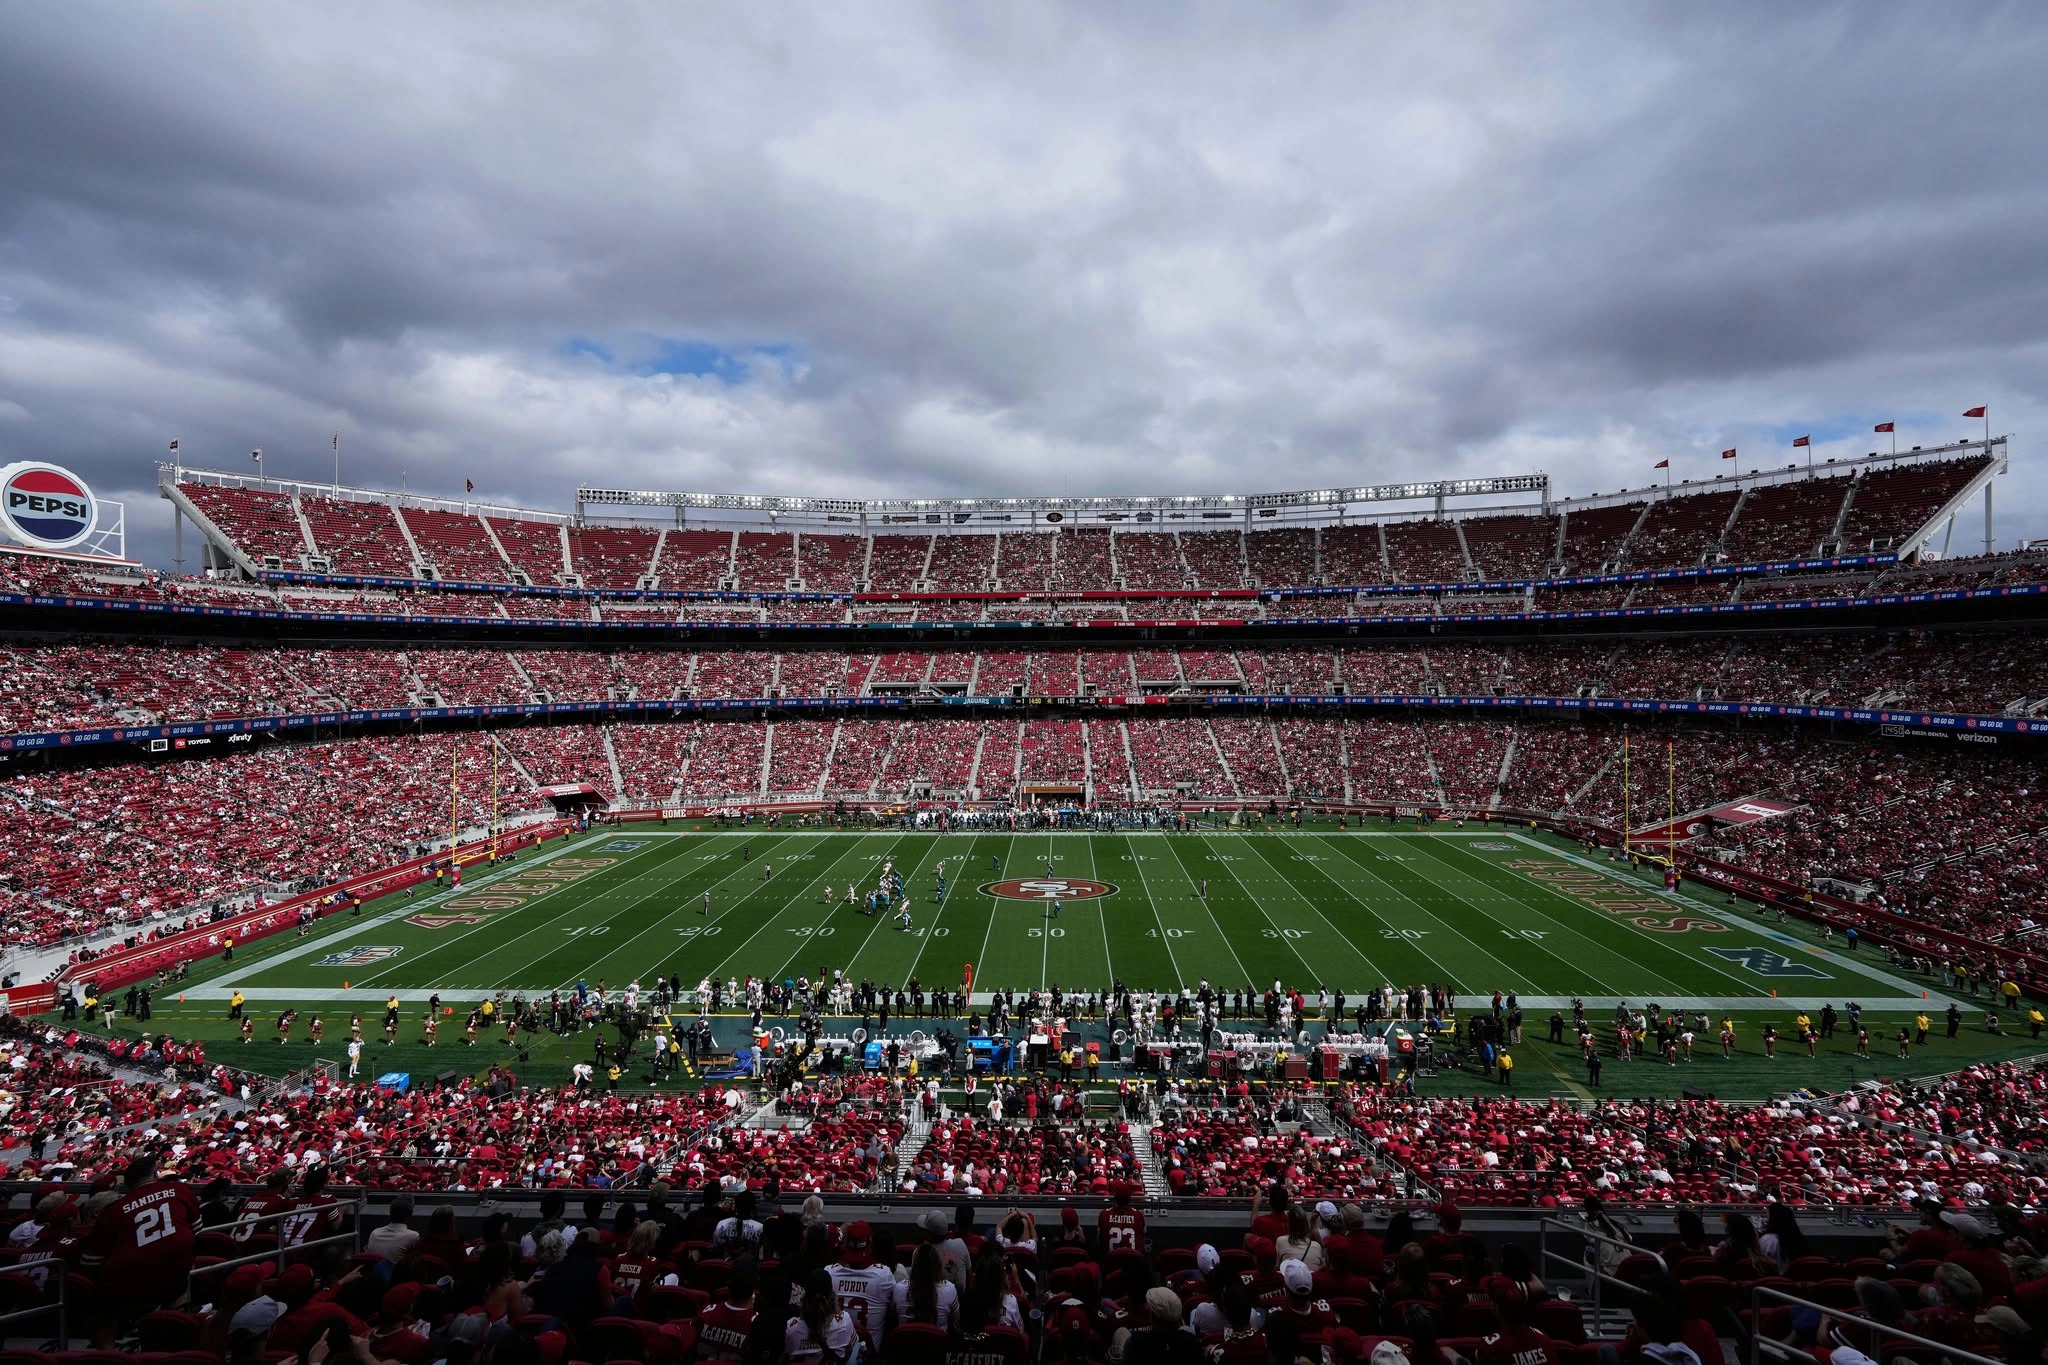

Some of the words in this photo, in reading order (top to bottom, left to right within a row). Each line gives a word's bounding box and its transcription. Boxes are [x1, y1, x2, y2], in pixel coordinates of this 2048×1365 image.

[10, 492, 87, 518] PEPSI
[1941, 717, 1947, 725] GO
[1980, 720, 1987, 728] GO
[1996, 721, 2003, 729] GO
[75, 734, 82, 742] GO
[83, 734, 91, 742] GO
[92, 733, 100, 741] GO
[127, 730, 134, 738] GO
[134, 729, 142, 738] GO
[142, 729, 149, 737] GO
[228, 733, 253, 743] xfinity
[1957, 733, 1998, 744] verizon
[17, 739, 26, 747] GO
[27, 738, 35, 746] GO
[36, 737, 45, 746] GO
[663, 809, 686, 818] HOME
[1438, 808, 1481, 819] Faithful
[403, 858, 619, 930] 49ERS
[1500, 859, 1735, 935] 49ERS
[1402, 1041, 1410, 1049] G
[122, 1189, 176, 1213] SANDERS
[245, 1201, 268, 1210] PURDY
[134, 1203, 177, 1247] 21
[1108, 1227, 1136, 1252] 23
[838, 1280, 869, 1293] PURDY
[701, 1323, 747, 1348] McCAFFREY
[1512, 1347, 1548, 1365] JAMES
